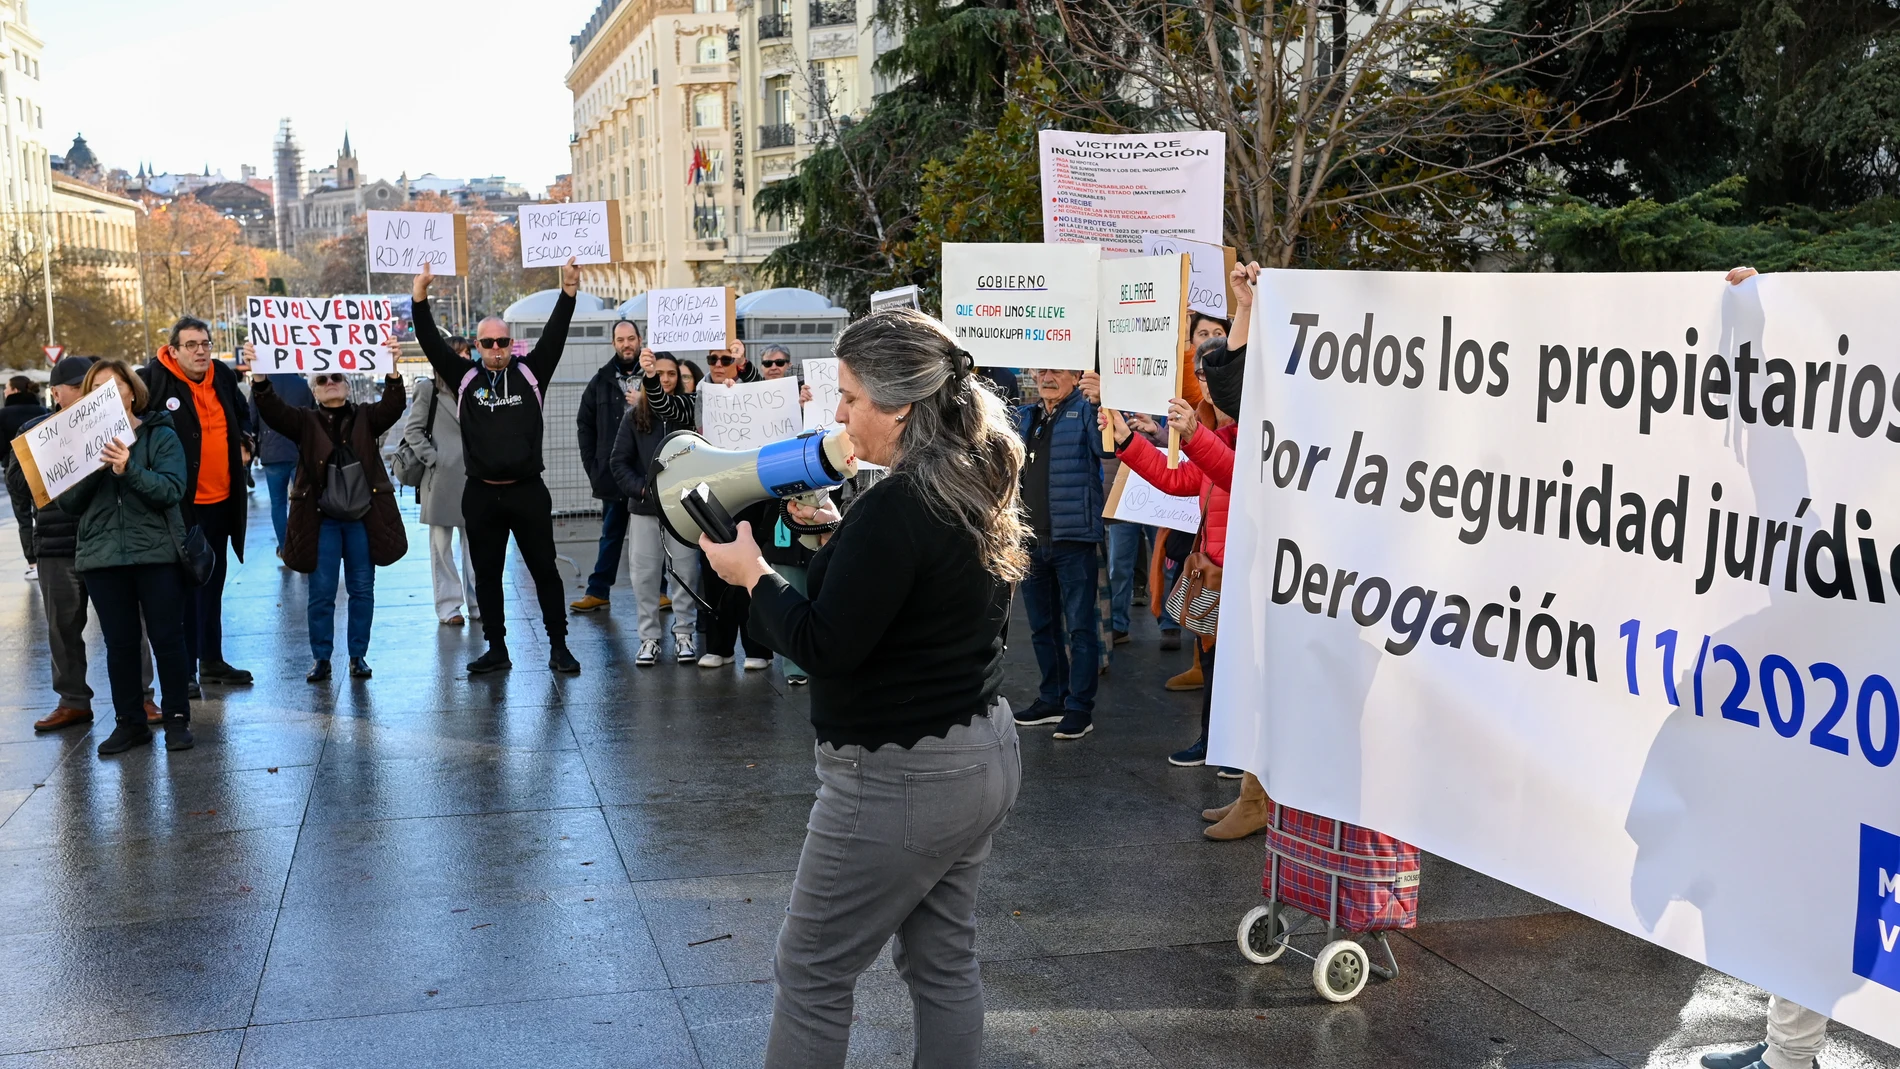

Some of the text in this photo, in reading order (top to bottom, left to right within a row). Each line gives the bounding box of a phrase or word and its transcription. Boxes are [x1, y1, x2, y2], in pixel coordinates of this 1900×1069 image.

[1052, 147, 1209, 160] INQUIOKUPACIÓN
[1076, 140, 1182, 150] VICTIMA DE
[1058, 185, 1094, 193] AYUNTAMIENTO
[1070, 199, 1092, 207] RECIBE
[386, 218, 442, 242] NO AL
[528, 209, 600, 230] PROPIETARIO
[1082, 218, 1117, 228] PROTEGE
[542, 228, 588, 242] NO ES
[376, 244, 447, 272] RD 11/2020
[528, 241, 608, 262] ESCUDO SOCIAL
[978, 275, 1045, 288] GOBIERNO
[249, 298, 392, 322] DEVOLVEDNOS
[658, 294, 718, 314] PROPIEDAD
[956, 304, 1065, 318] QUE CADA UNO SE LLEVE
[658, 312, 703, 327] PRIVADA
[251, 322, 391, 346] NUESTROS
[652, 330, 689, 344] DERECHO
[956, 326, 1070, 342] UN INQUIOKUPA A SU CASA
[274, 348, 376, 370] PISOS
[1284, 312, 1426, 391] Todos
[1438, 316, 1510, 397] los
[1153, 359, 1168, 377] CASA
[38, 422, 58, 447] SIN
[60, 409, 110, 448] AL COBRAR
[714, 418, 794, 444] POR UNA
[46, 455, 80, 488] NADIE
[1261, 420, 1332, 492] Por
[1335, 430, 1388, 506] la
[1400, 459, 1690, 564] seguridad
[1272, 538, 1900, 768] Derogación 11/2020
